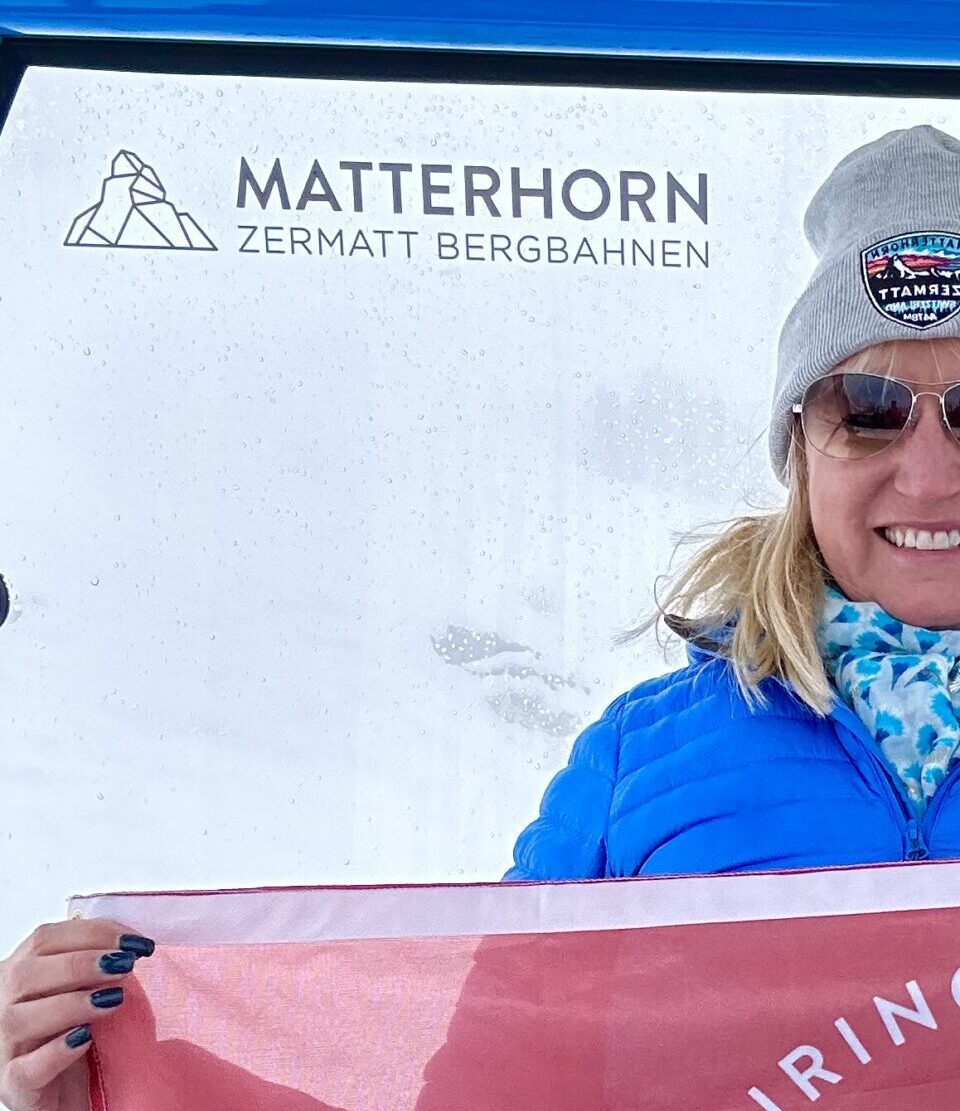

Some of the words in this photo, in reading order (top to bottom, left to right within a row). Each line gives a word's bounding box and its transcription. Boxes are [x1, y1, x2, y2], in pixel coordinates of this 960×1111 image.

[236, 156, 708, 225] MATTERHORN
[237, 225, 418, 260] ZERMATT
[438, 233, 710, 268] BERGBAHNEN
